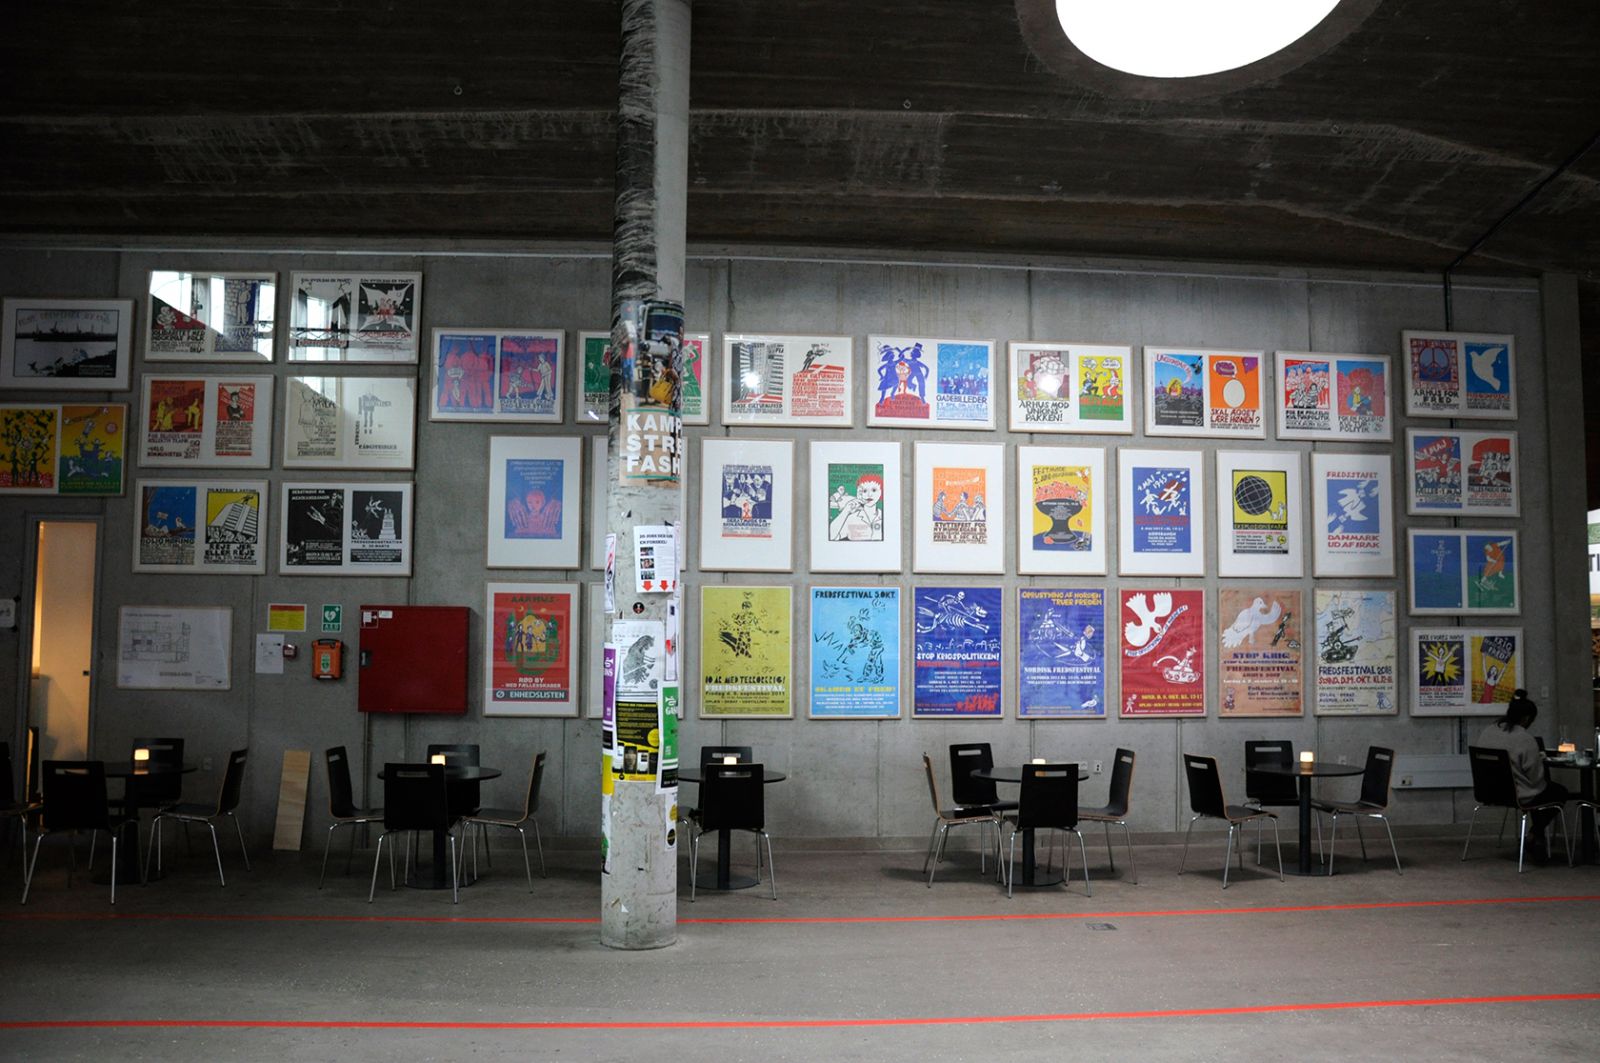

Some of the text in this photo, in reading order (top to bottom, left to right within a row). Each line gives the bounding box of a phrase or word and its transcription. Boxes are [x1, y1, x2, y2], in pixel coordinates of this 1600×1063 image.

[1019, 400, 1049, 408] ÅRHUS
[1026, 414, 1063, 422] PAKKEN!
[815, 591, 872, 599] FREDSFESTIVAL
[1494, 637, 1513, 650] KRIG
[1318, 666, 1376, 675] FREDSFESTIVAL
